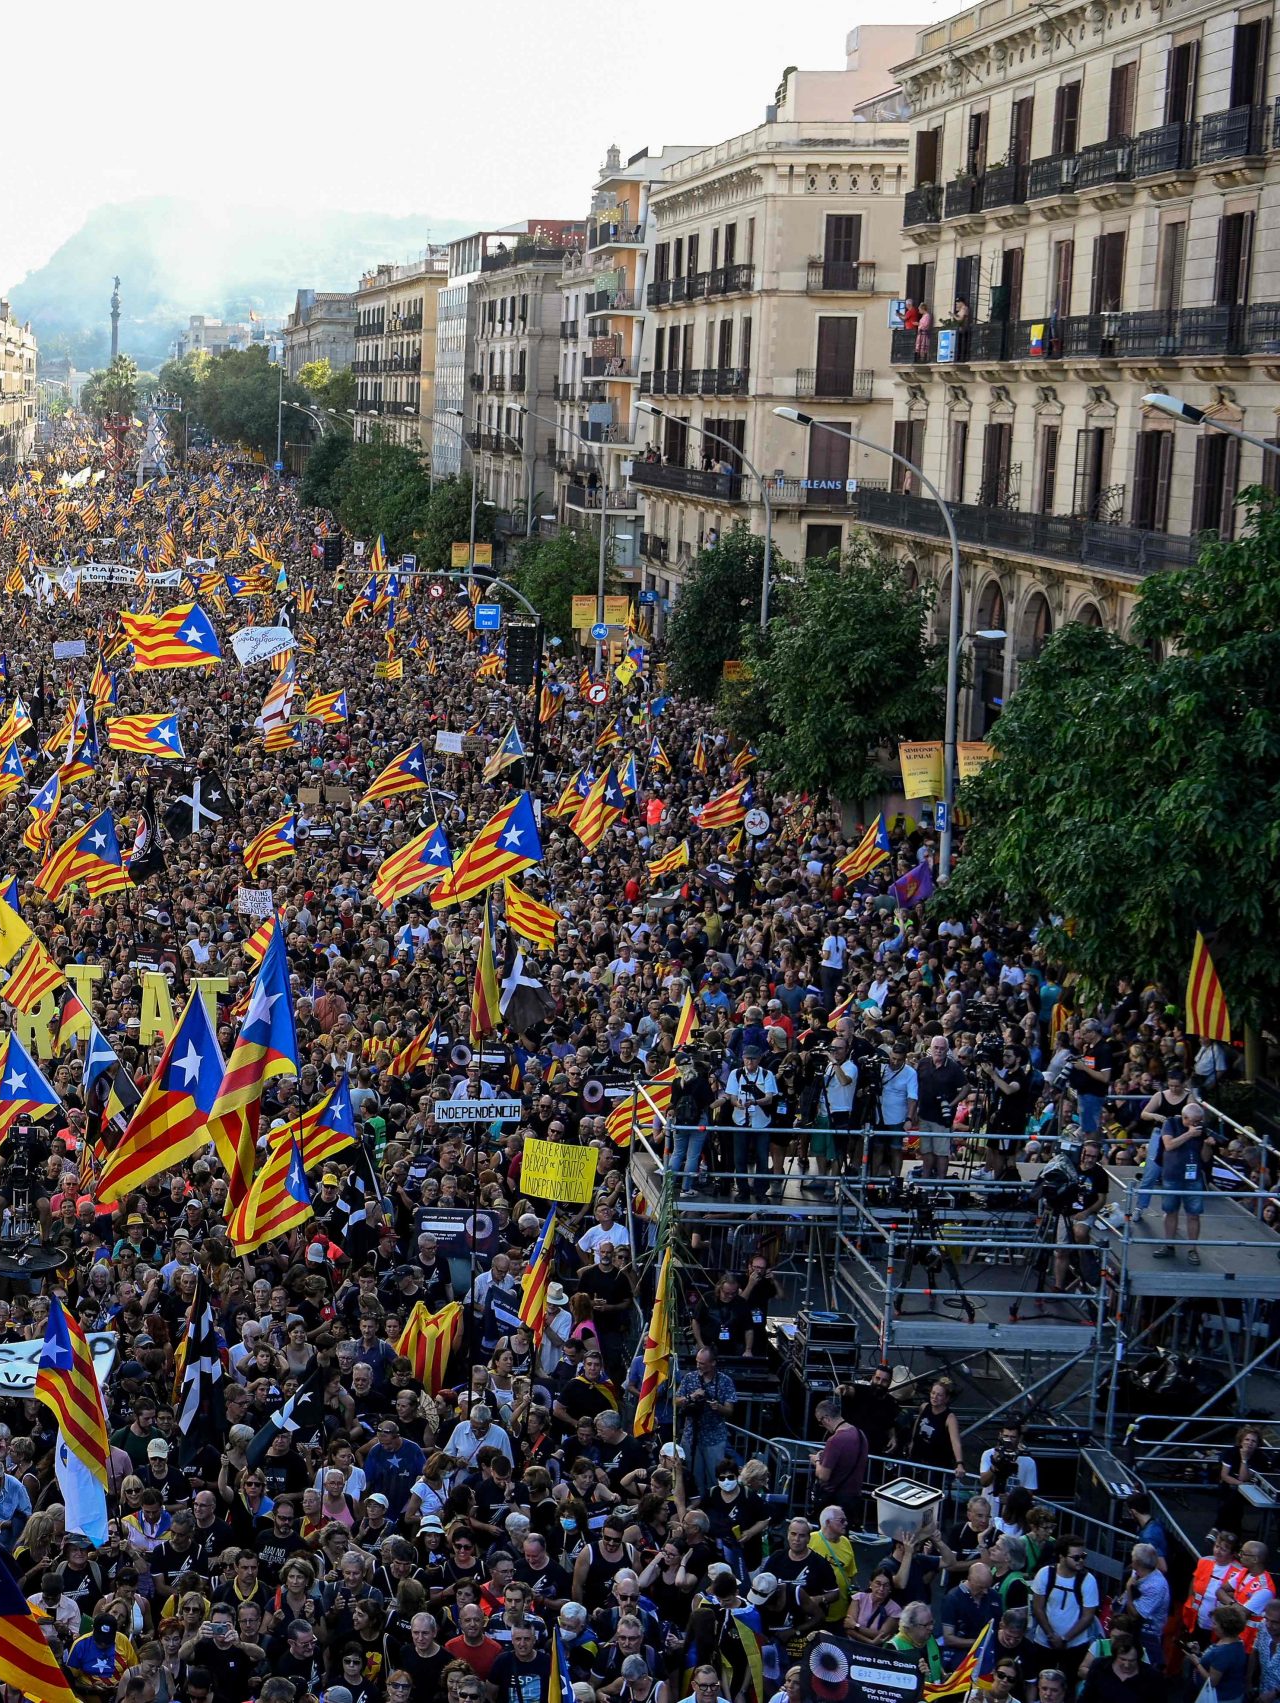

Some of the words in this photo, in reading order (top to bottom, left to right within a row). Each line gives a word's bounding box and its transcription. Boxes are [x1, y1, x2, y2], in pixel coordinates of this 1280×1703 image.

[938, 805, 944, 816] P
[852, 1654, 872, 1663] Here
[892, 1660, 917, 1669] Spain
[861, 1686, 876, 1694] Spy
